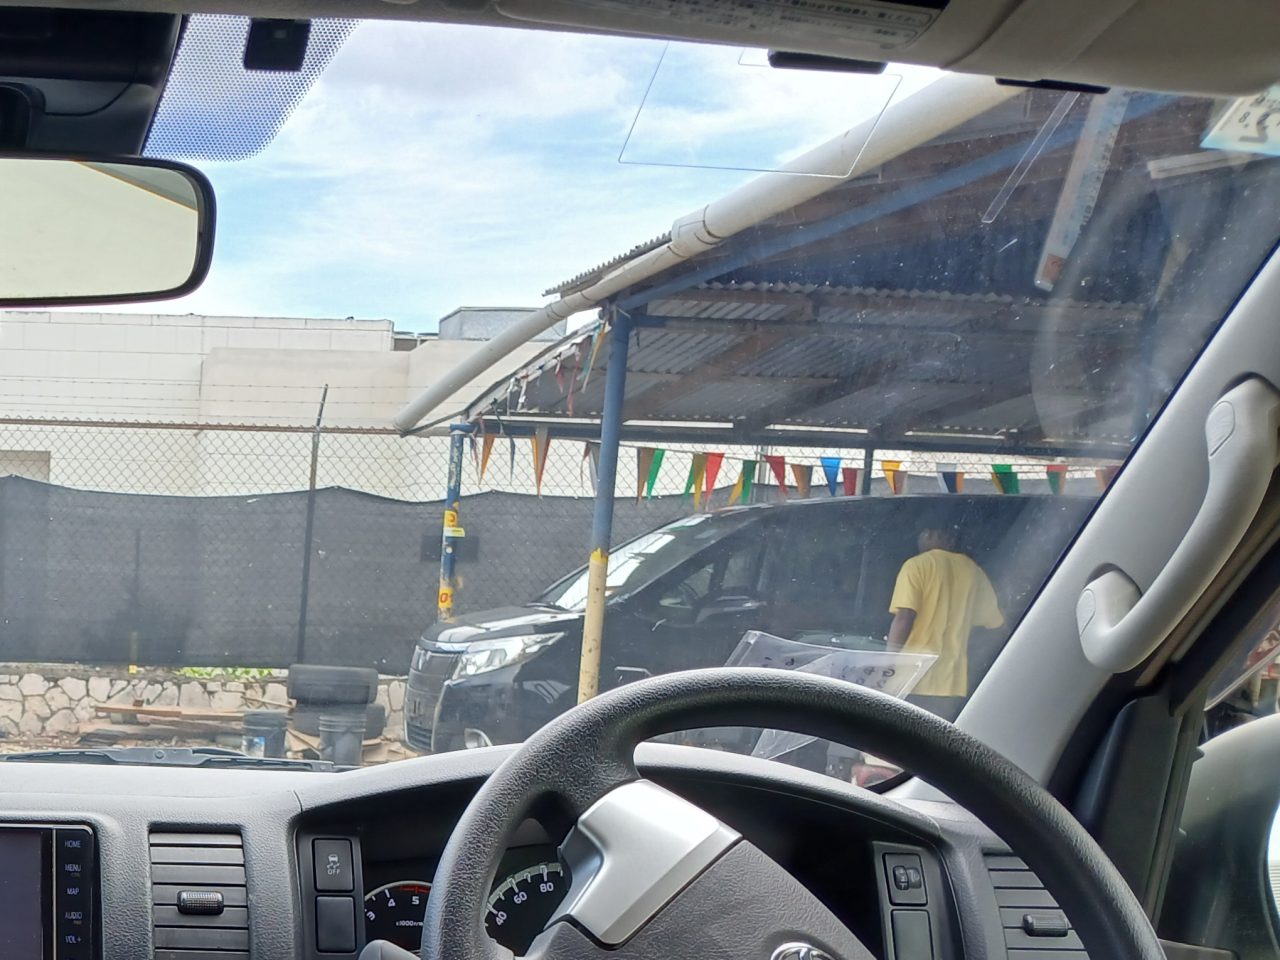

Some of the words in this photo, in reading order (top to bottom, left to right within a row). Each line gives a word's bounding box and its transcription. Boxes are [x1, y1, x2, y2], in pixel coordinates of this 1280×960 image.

[64, 840, 81, 848] HOME
[64, 864, 82, 872] MENU
[66, 887, 80, 895] MAP
[539, 882, 554, 893] 80
[411, 896, 420, 905] 5
[513, 890, 528, 905] 60
[387, 898, 396, 907] 4
[64, 912, 83, 920] AUDIO
[366, 911, 376, 921] 3
[495, 910, 508, 926] 40
